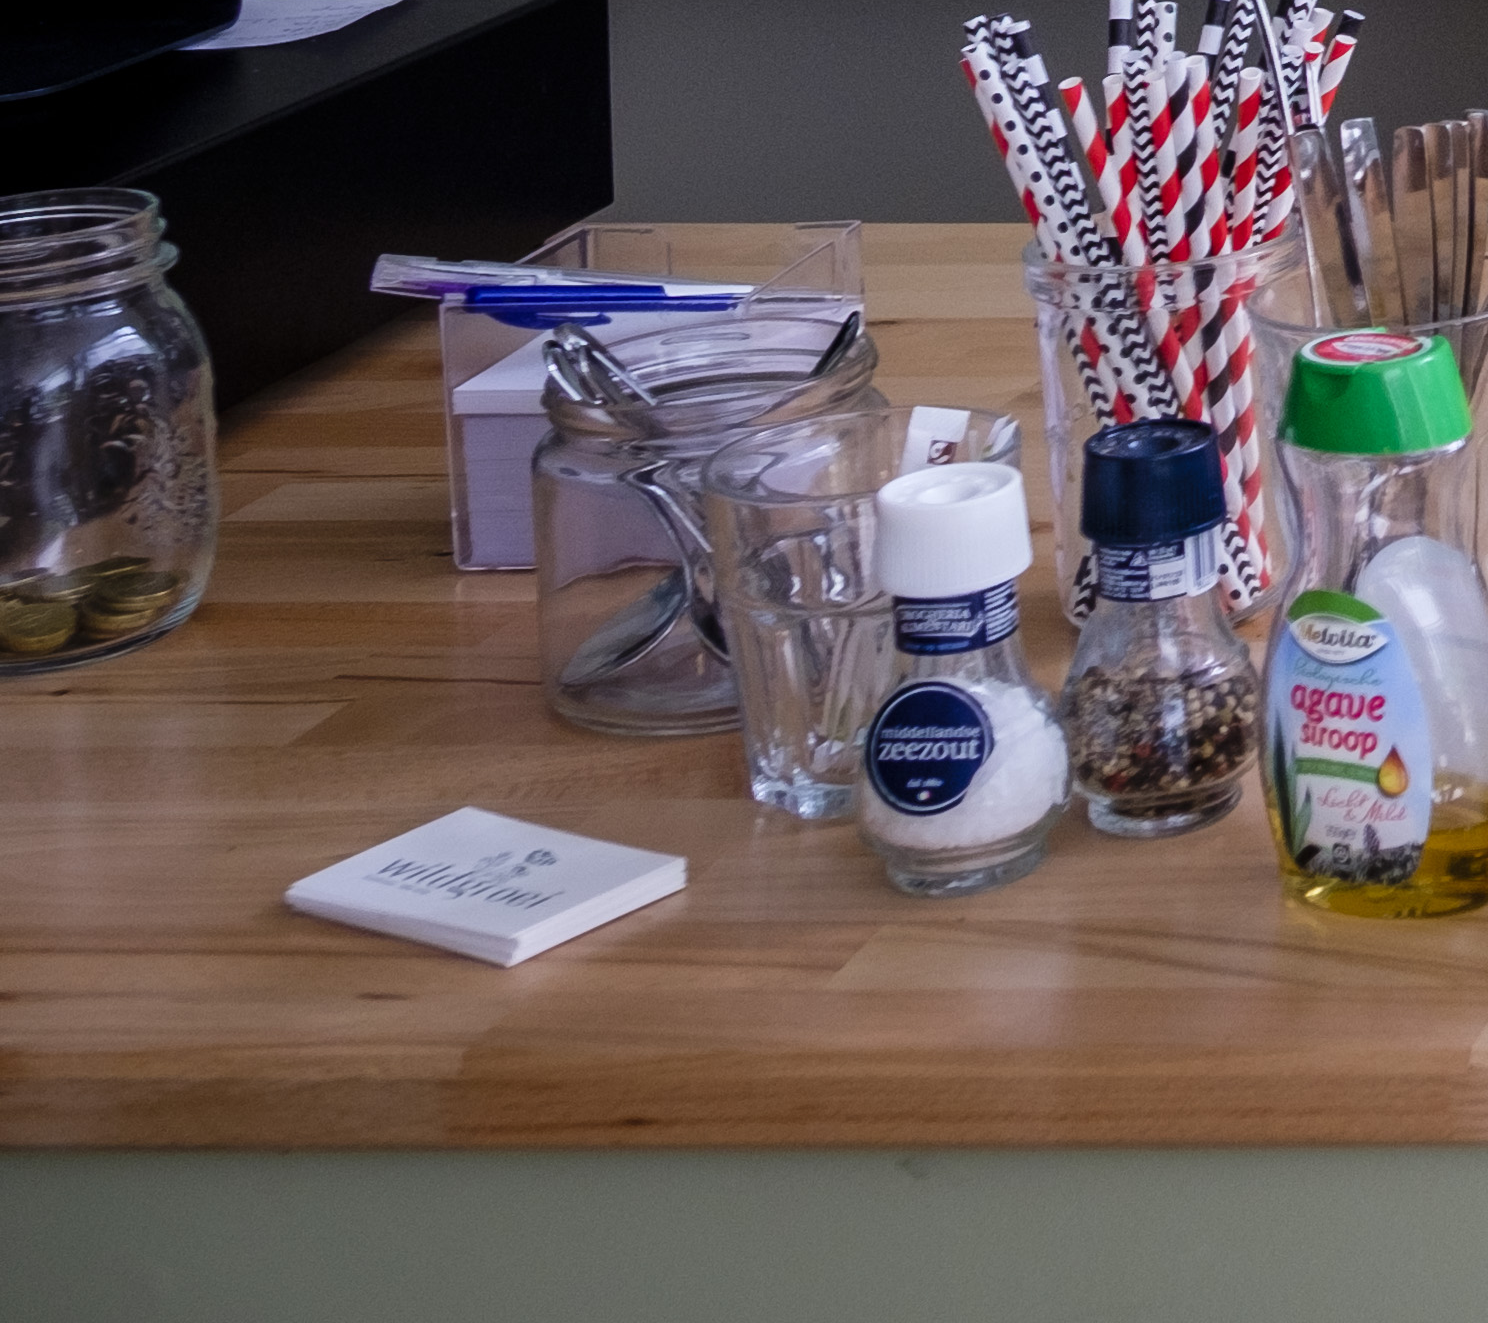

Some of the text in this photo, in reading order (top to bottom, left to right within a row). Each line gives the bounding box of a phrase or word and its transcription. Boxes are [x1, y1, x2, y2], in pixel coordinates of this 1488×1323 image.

[1291, 684, 1386, 725] agave
[877, 738, 981, 761] zeezout
[880, 725, 981, 739] middellandse
[1300, 722, 1378, 760] siroop
[377, 857, 567, 911] wildgroei
